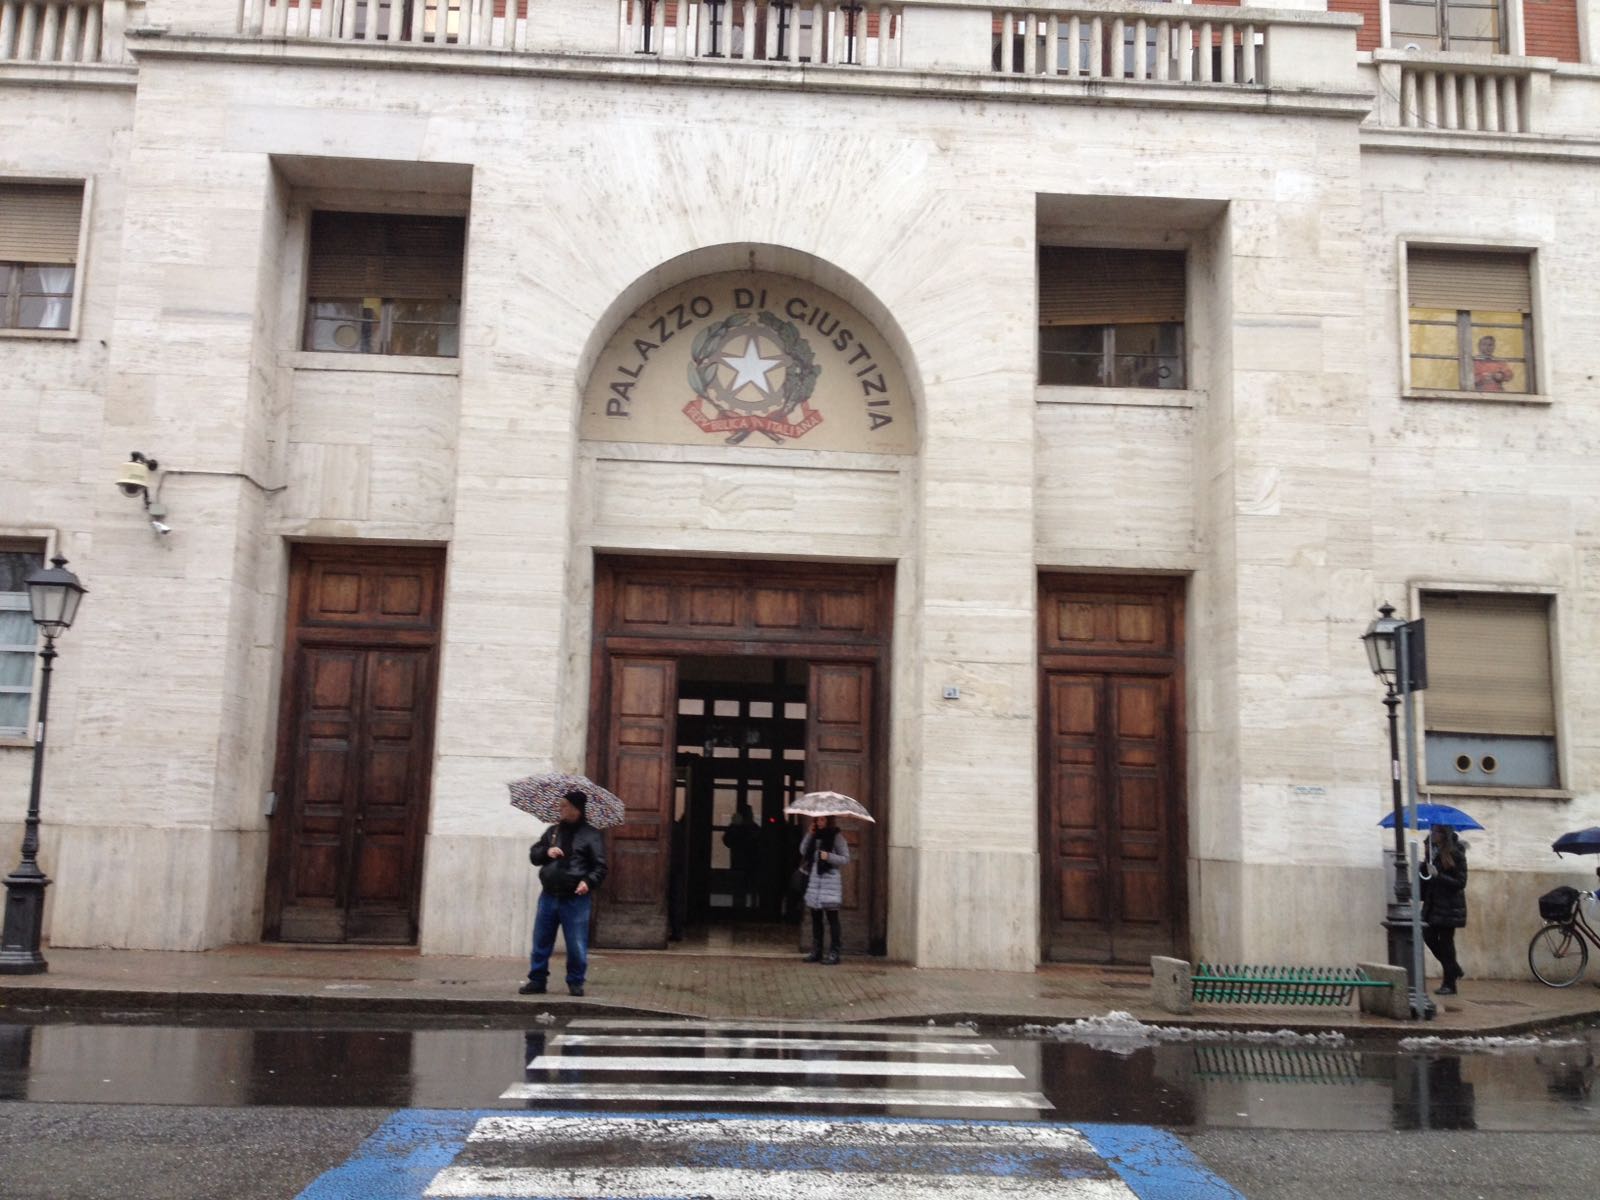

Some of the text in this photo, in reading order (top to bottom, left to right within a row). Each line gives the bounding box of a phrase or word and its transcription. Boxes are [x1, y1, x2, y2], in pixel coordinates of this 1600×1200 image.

[606, 289, 893, 431] PALAZZO DI GIUSTIZIA
